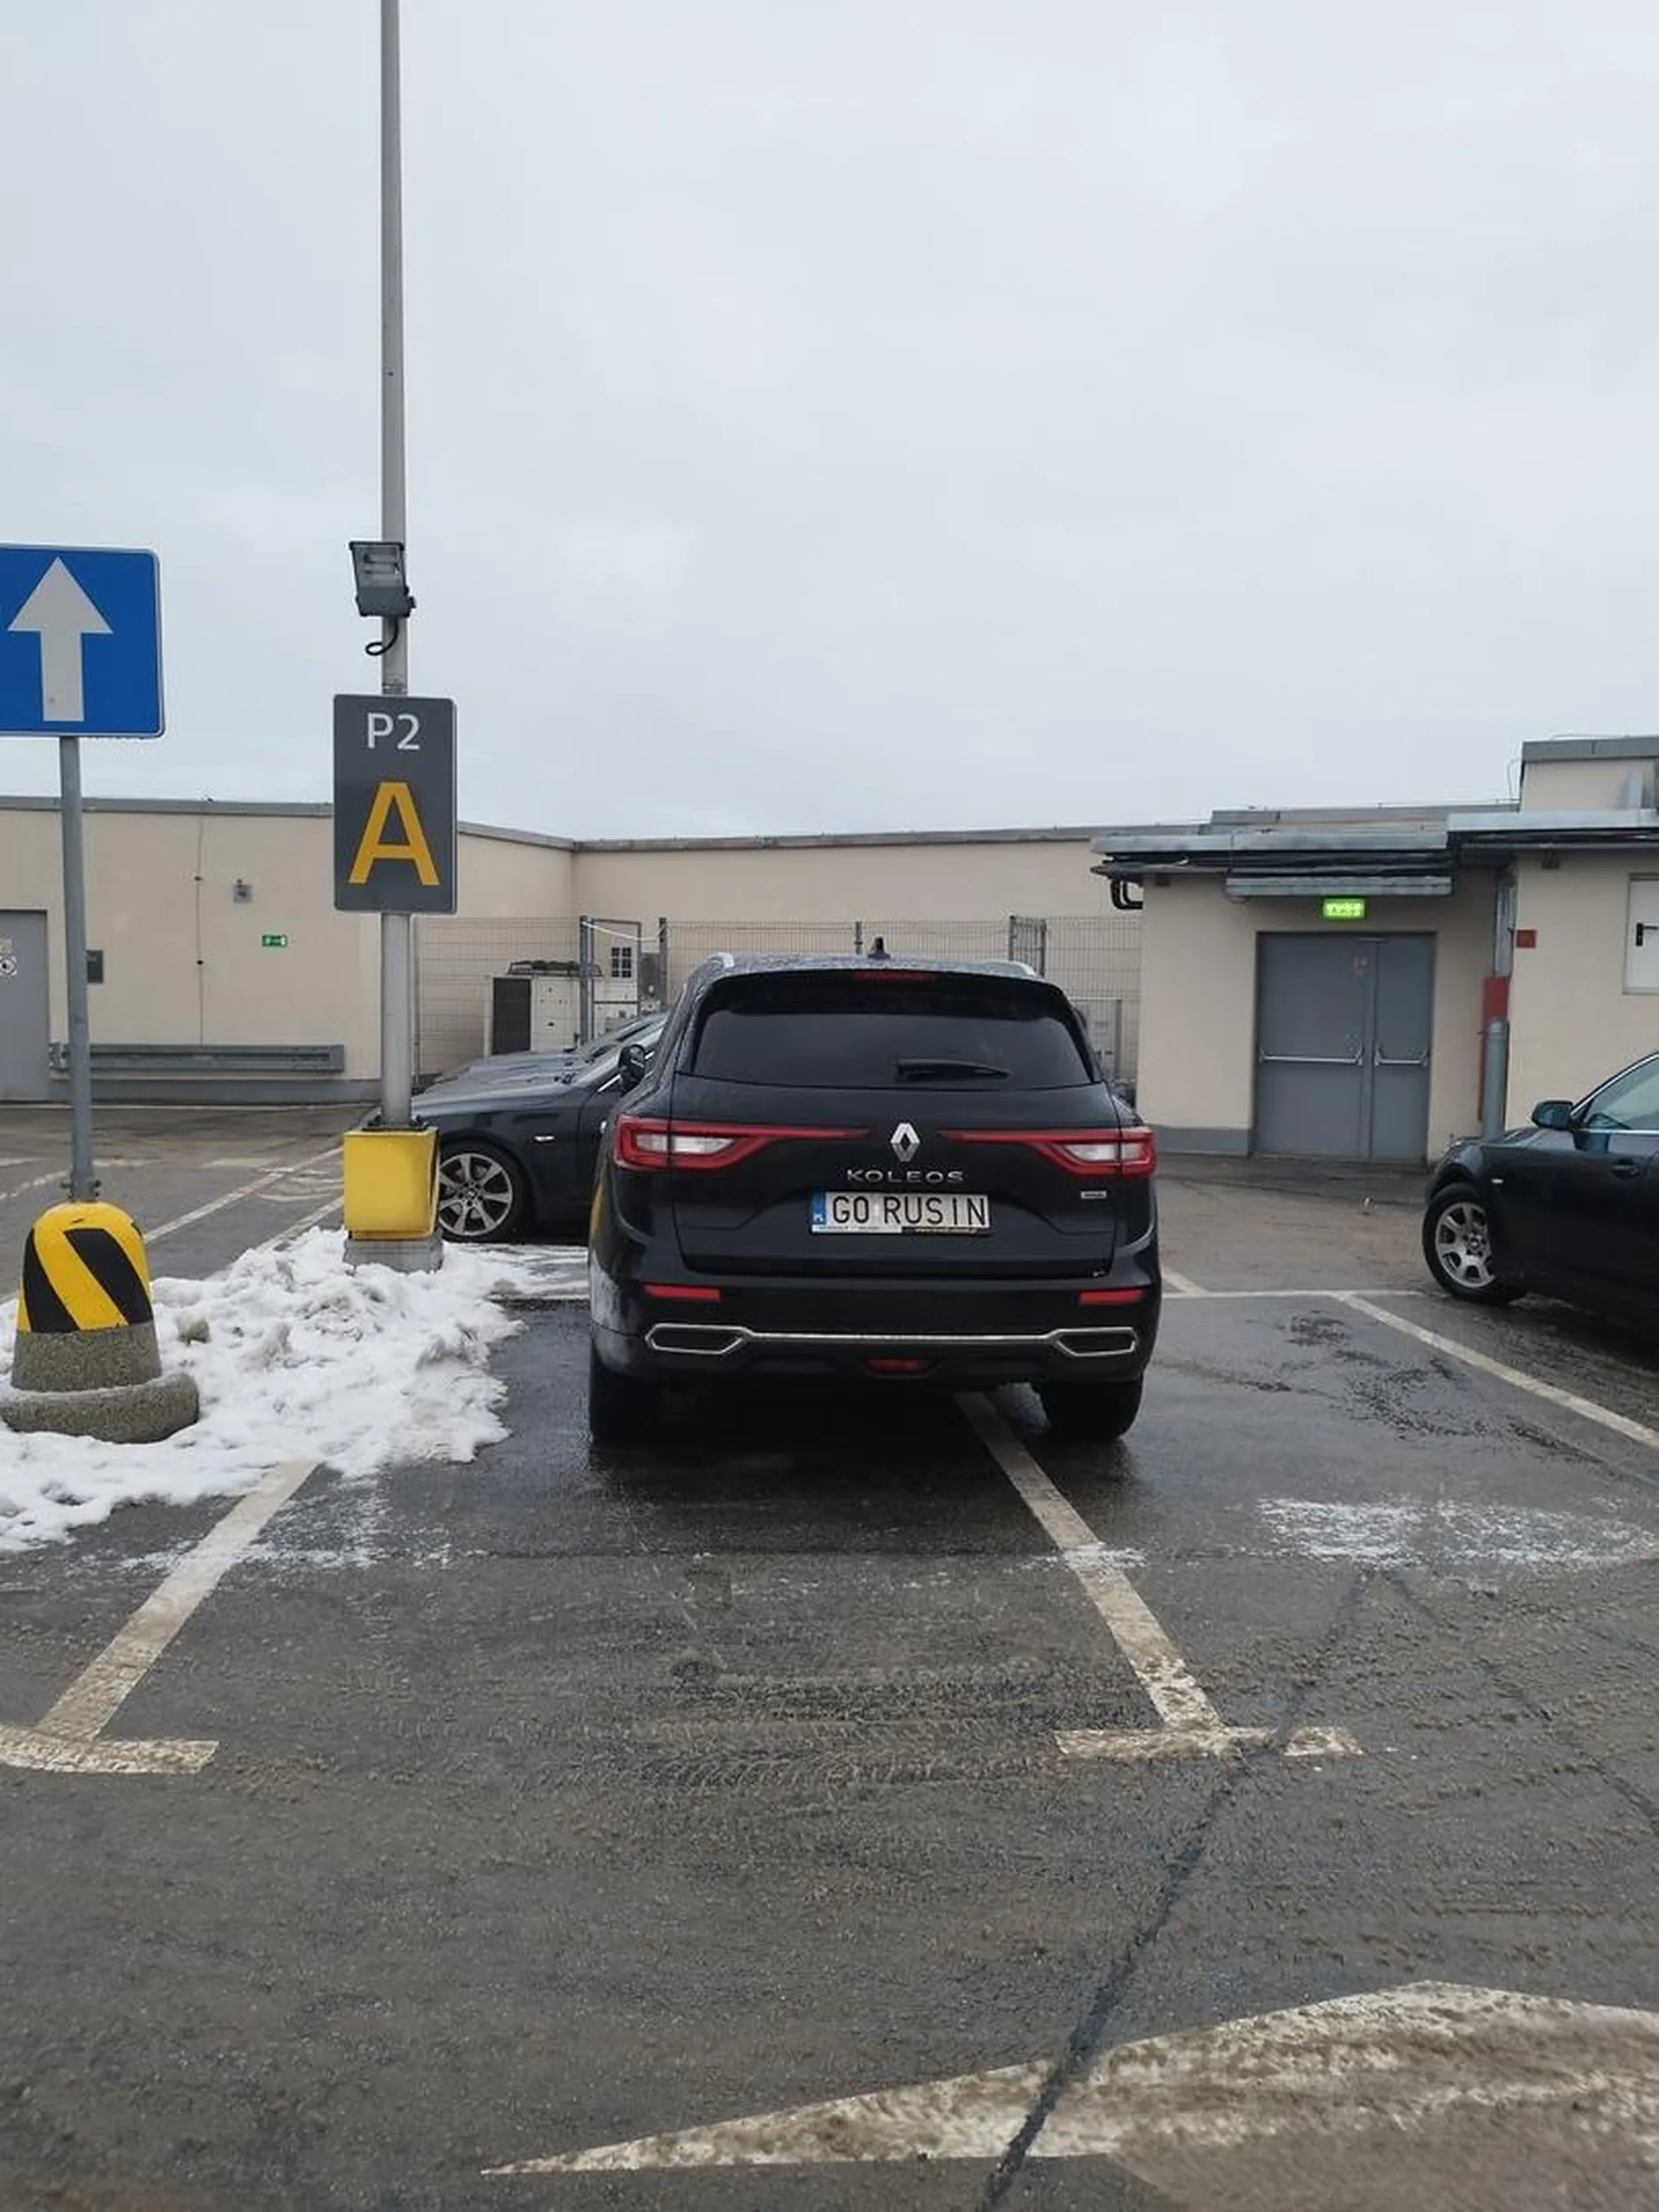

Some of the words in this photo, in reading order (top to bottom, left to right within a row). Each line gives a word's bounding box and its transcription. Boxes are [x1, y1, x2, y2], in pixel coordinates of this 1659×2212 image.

[366, 711, 420, 750] P2
[348, 780, 441, 886] A
[846, 1169, 964, 1183] KOLEOS
